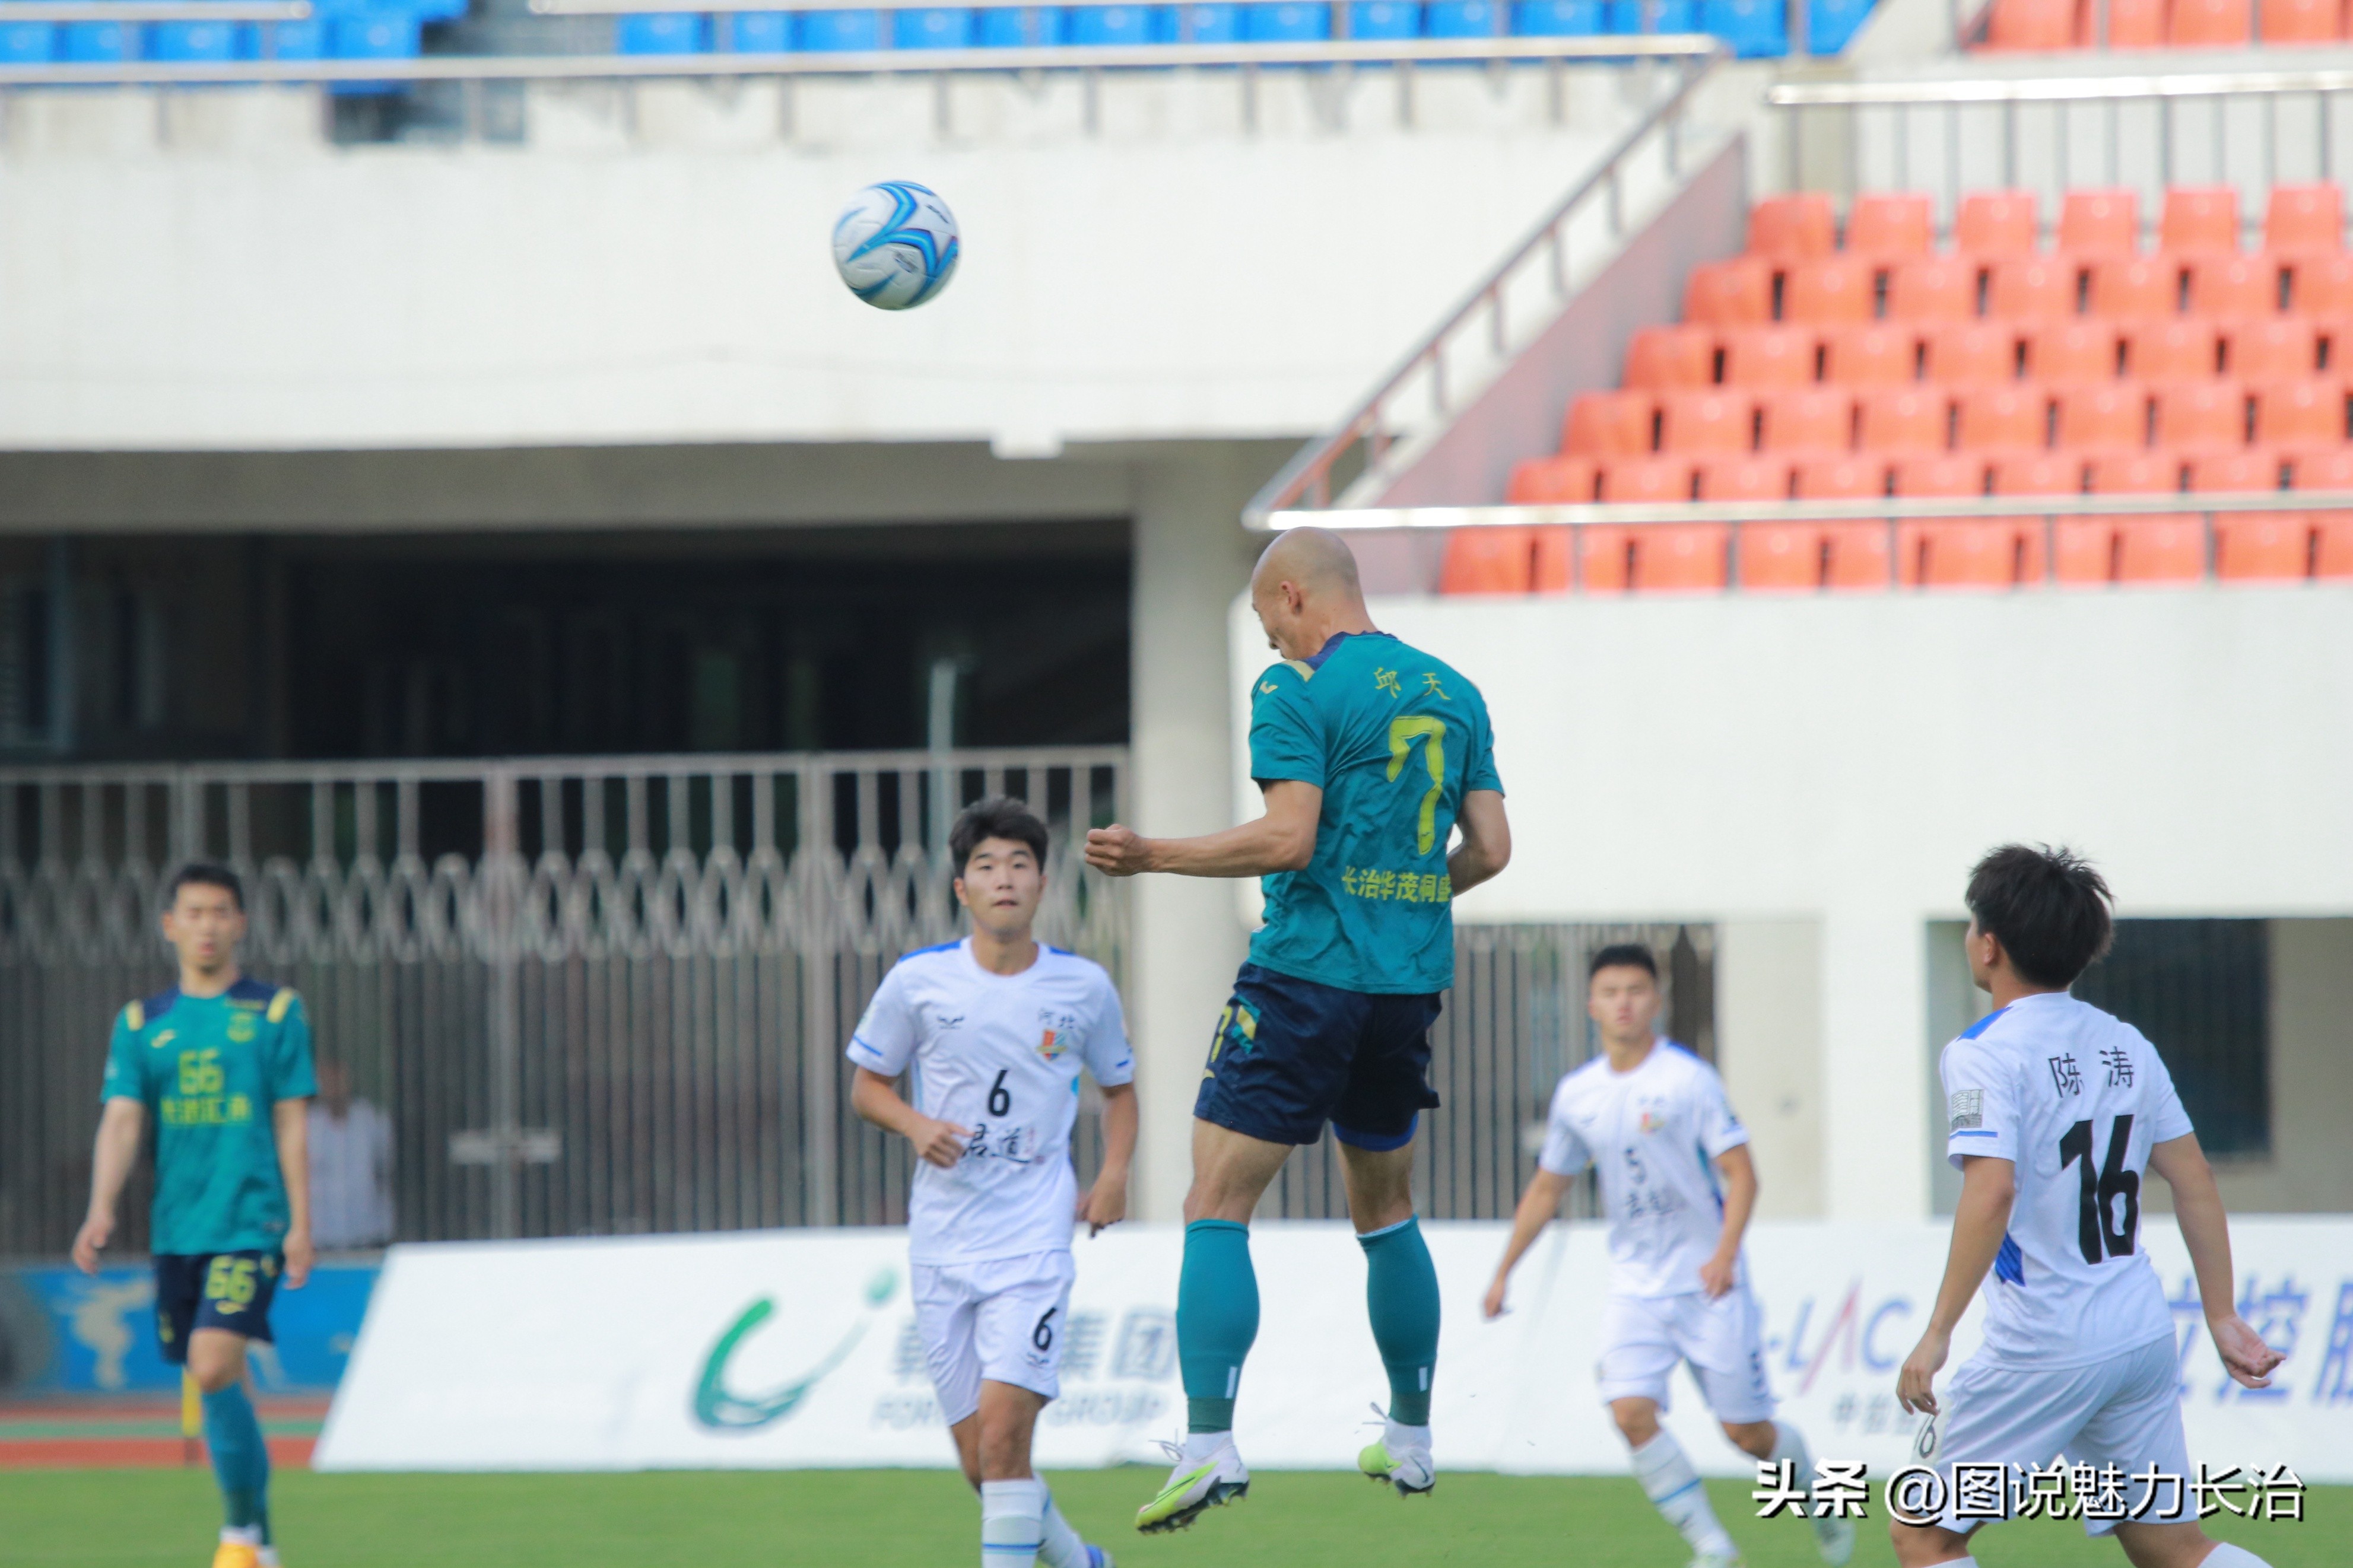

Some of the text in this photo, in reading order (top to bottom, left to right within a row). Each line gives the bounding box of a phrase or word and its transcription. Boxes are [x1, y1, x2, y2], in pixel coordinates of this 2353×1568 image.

[1386, 715, 1447, 855] 7
[987, 1069, 1010, 1117] 6
[2047, 1045, 2135, 1098] 陈涛
[2059, 1113, 2139, 1265] 16
[1033, 1307, 1058, 1351] 6
